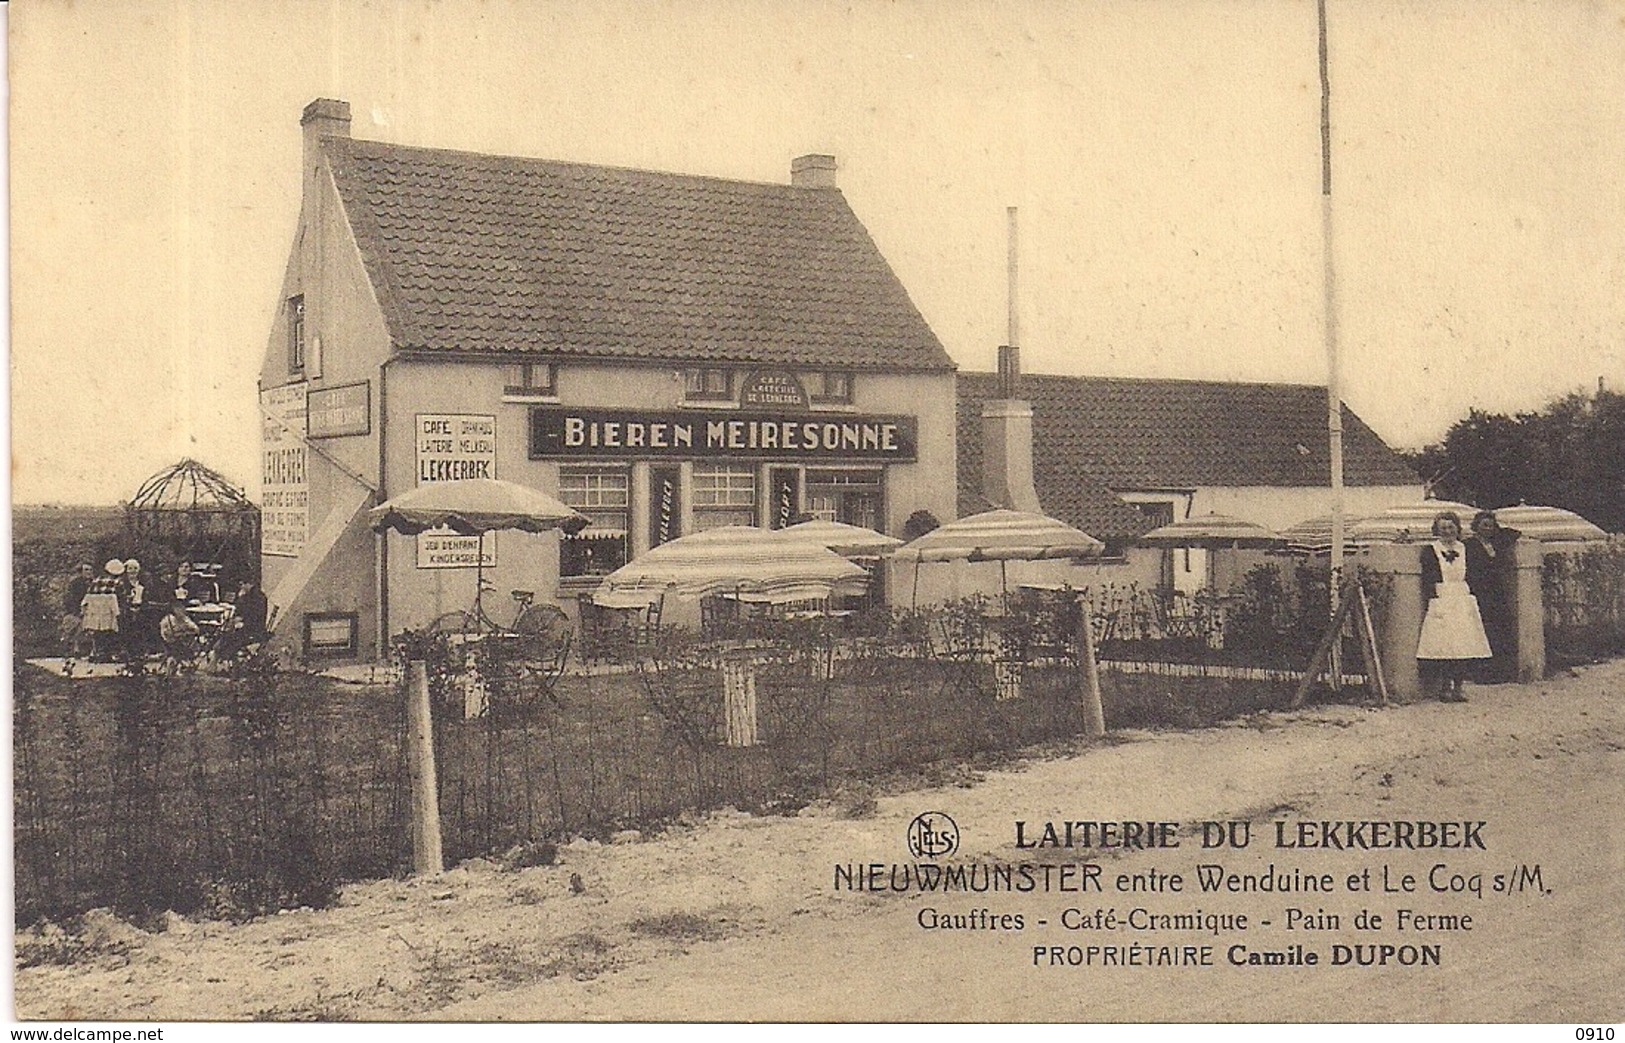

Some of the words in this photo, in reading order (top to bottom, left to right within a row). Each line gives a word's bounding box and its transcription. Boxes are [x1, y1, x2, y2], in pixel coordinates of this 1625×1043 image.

[565, 417, 692, 447] BIEREN
[706, 420, 898, 450] MEIRESONNE
[420, 459, 490, 482] LEKKERBEK
